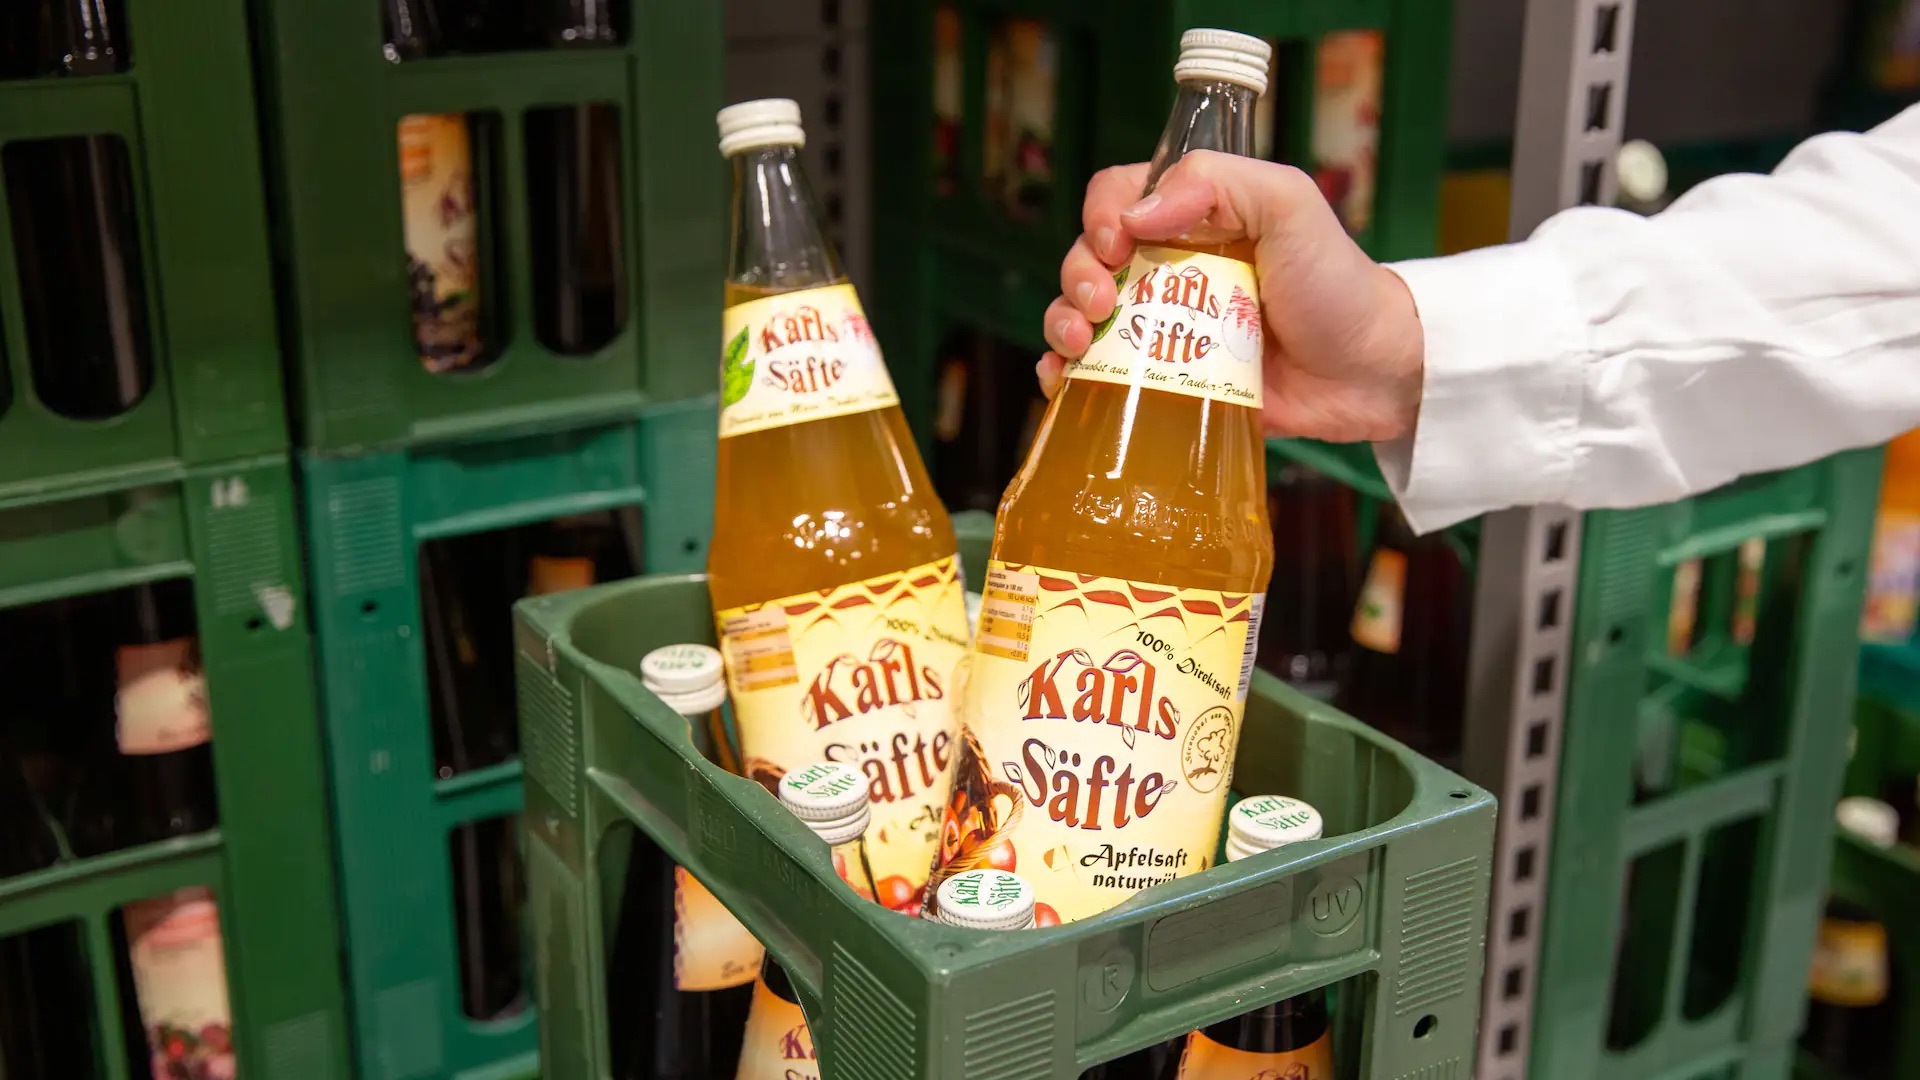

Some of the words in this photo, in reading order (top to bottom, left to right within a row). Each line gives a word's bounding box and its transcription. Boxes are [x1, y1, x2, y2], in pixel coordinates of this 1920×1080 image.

[1131, 266, 1221, 320] Karls
[760, 307, 840, 354] Karls
[1124, 314, 1214, 364] Säfte
[766, 356, 844, 394] Säfte
[1136, 631, 1175, 660] 100%
[1176, 658, 1231, 700] Direktsaft
[806, 639, 944, 731] Karls
[1020, 649, 1178, 741] Karls
[788, 764, 839, 790] Karls
[807, 773, 856, 797] Säfte
[1012, 738, 1168, 831] Säfte
[1239, 796, 1297, 818] Karls
[1256, 811, 1310, 829] Säfte
[1080, 844, 1188, 871] Apfelsaft
[951, 873, 984, 905] Karls
[986, 875, 1022, 906] Säfte
[1312, 888, 1351, 921] UV
